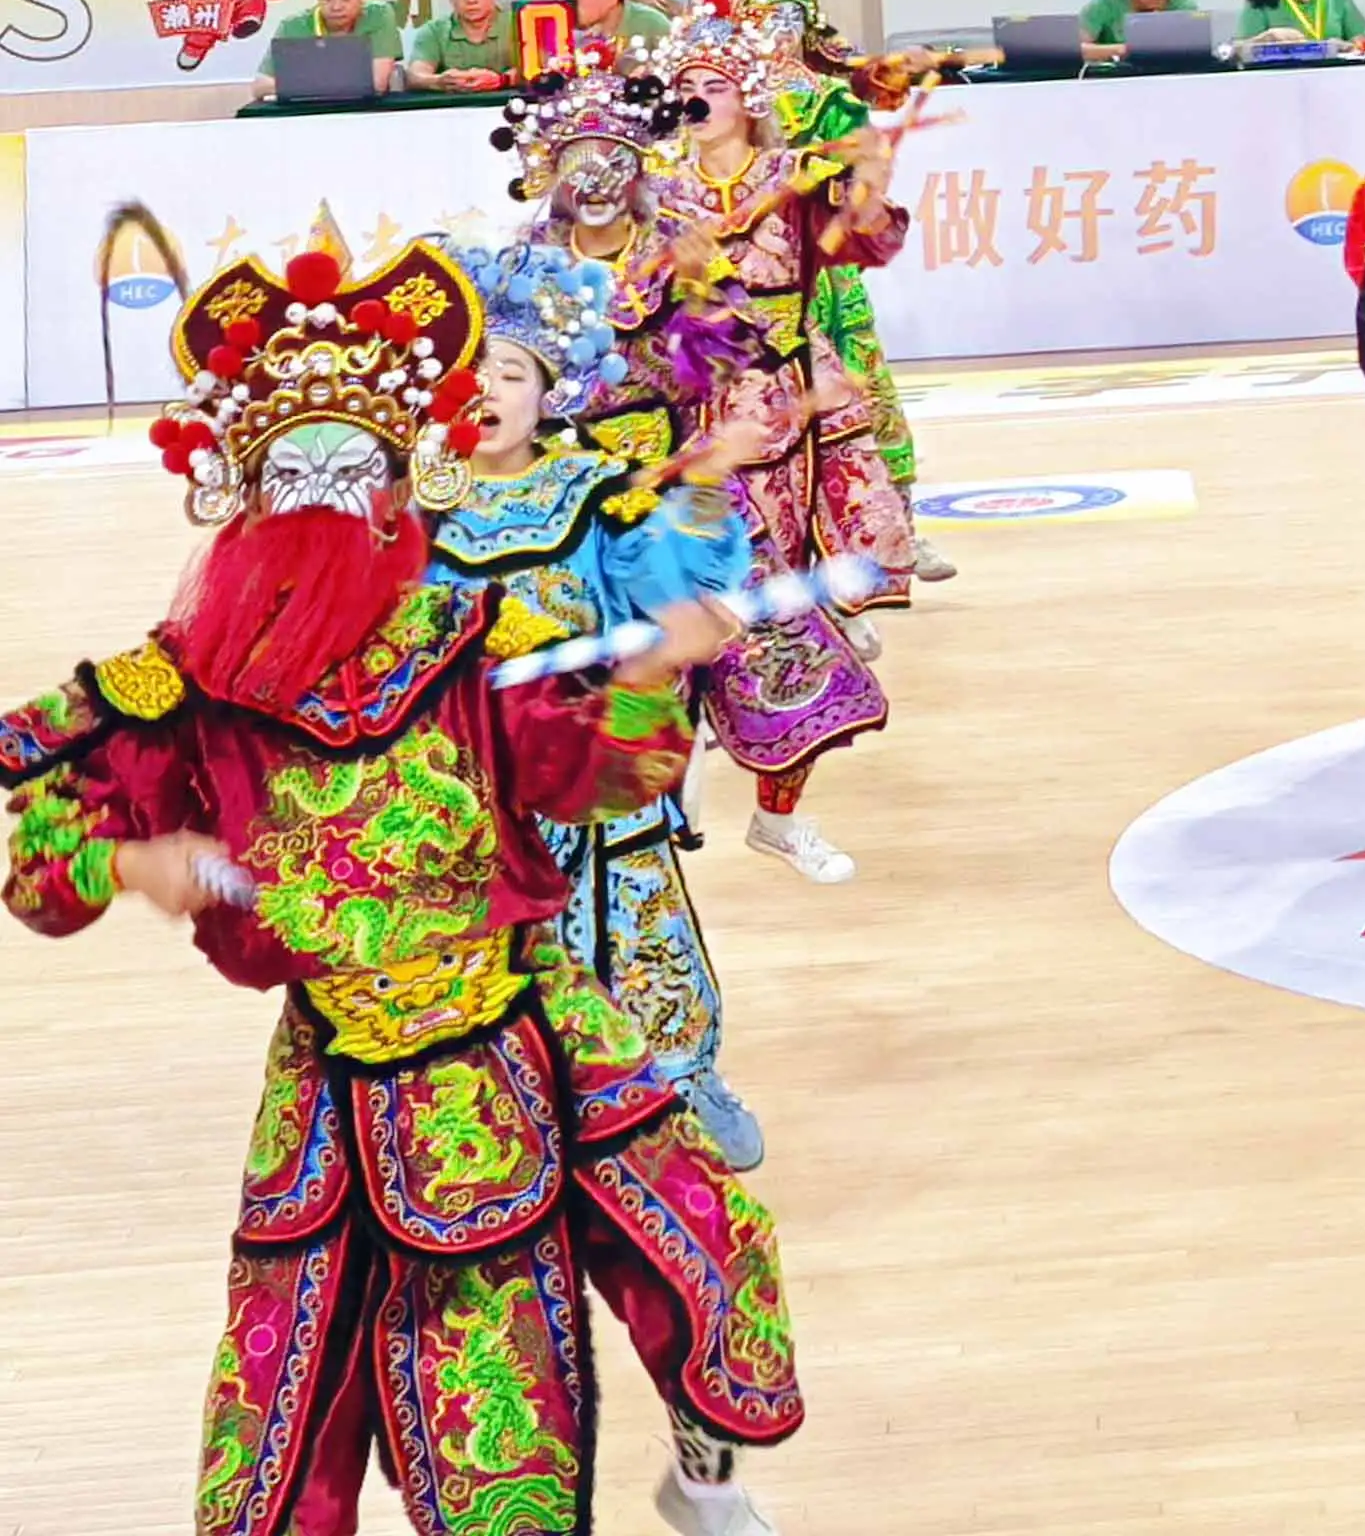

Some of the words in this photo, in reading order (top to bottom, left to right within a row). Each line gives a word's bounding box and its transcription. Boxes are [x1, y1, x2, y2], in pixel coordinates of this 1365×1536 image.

[159, 5, 220, 32] 潮州
[915, 159, 1217, 272] 做好药
